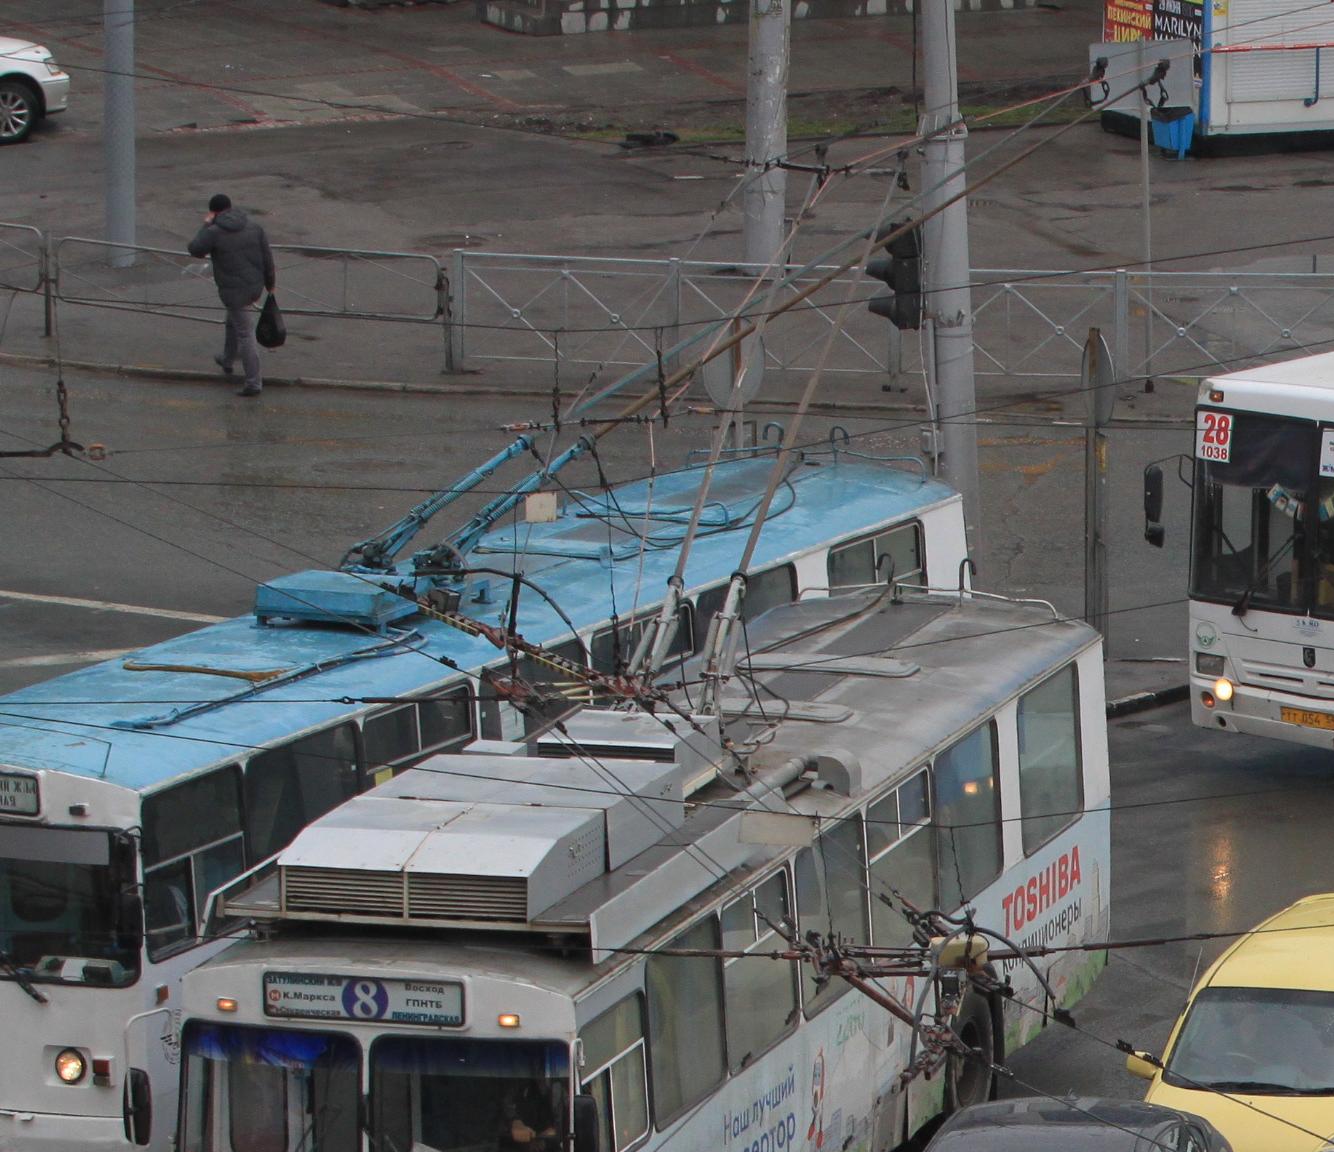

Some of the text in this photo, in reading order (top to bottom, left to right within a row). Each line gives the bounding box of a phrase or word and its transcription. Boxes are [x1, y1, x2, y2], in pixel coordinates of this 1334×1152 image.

[1154, 12, 1202, 40] MARILYN
[1203, 413, 1230, 446] 28
[1200, 445, 1229, 461] 1038
[1002, 845, 1081, 939] TOSHIBA
[283, 992, 336, 1002] К.Маркса
[353, 979, 379, 1018] 8
[404, 983, 445, 994] Восход
[406, 998, 443, 1009] ГПНТБ
[723, 1064, 796, 1146] Наш лучший
